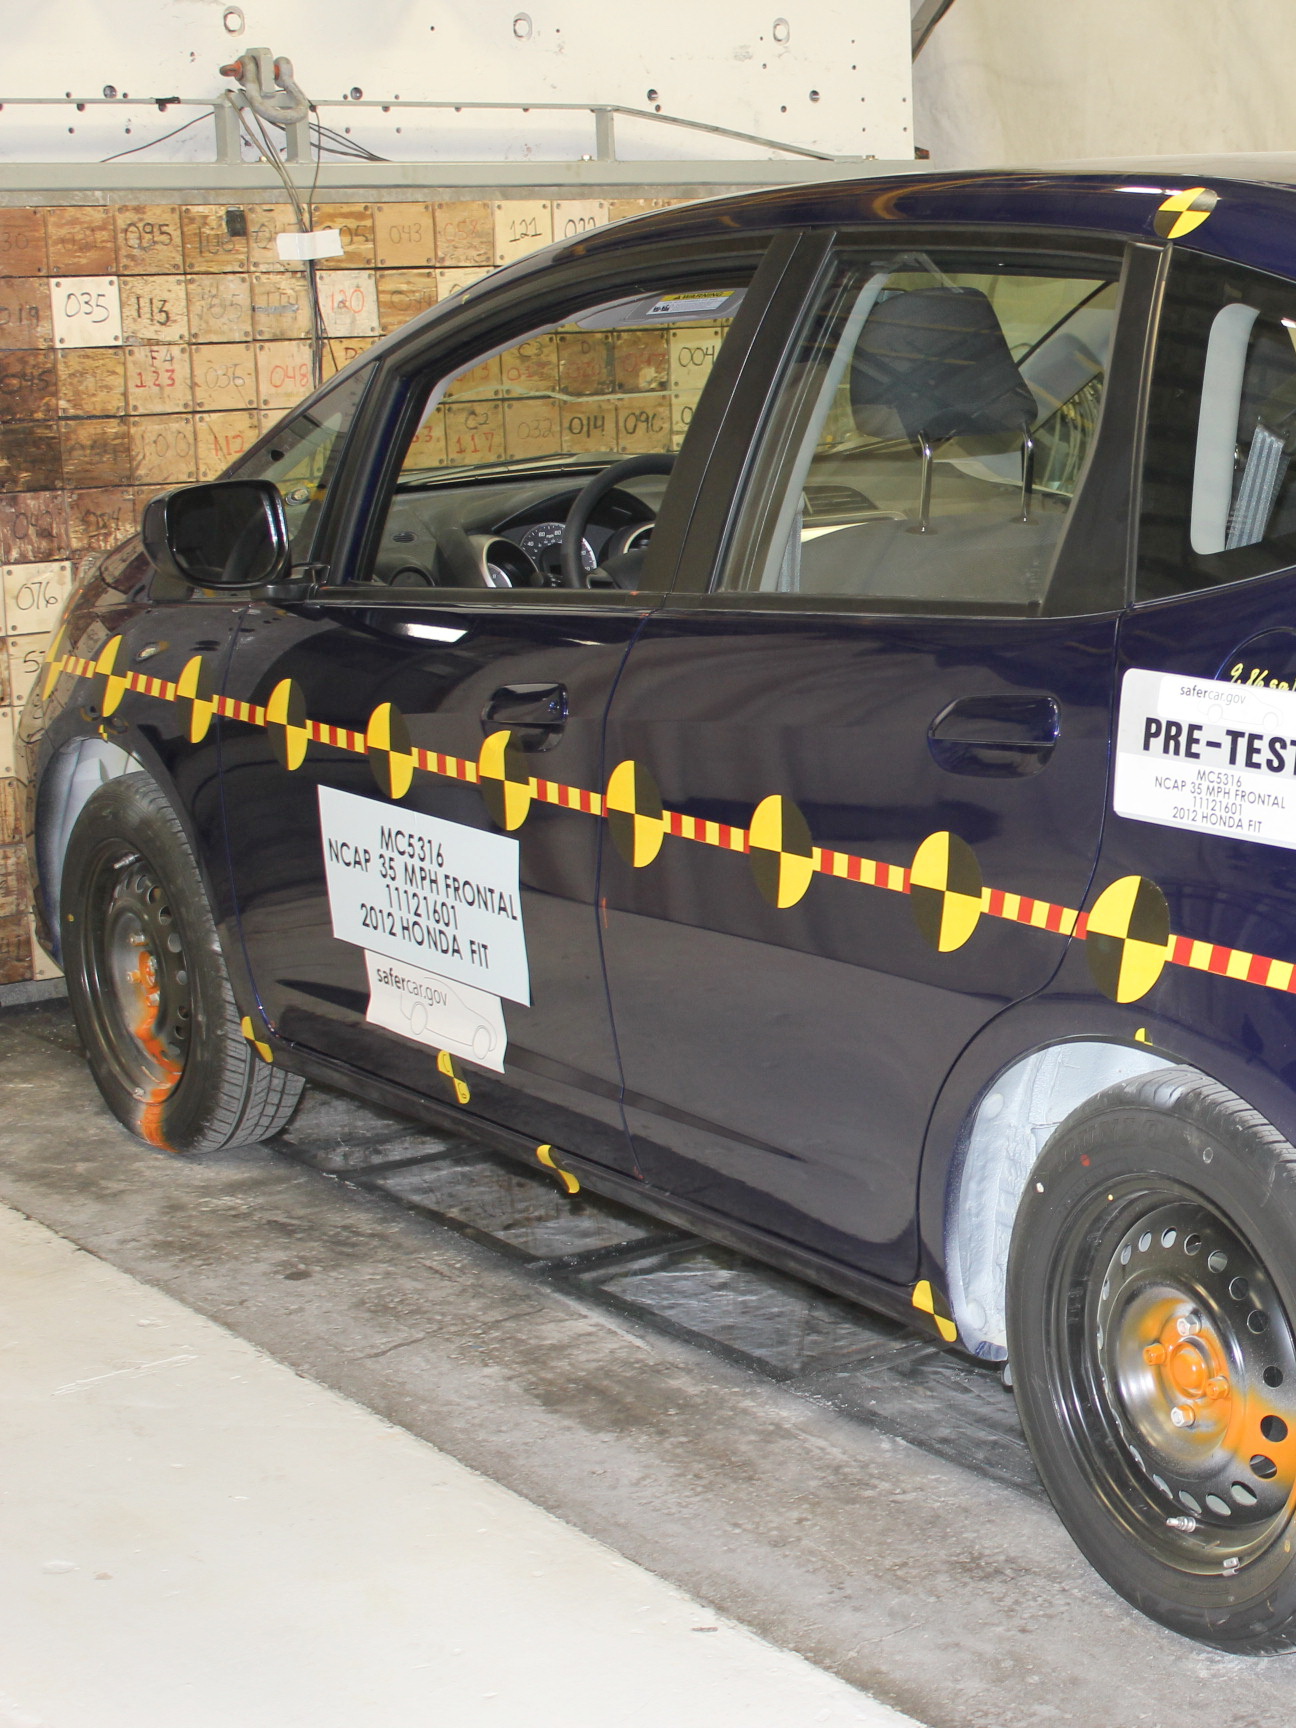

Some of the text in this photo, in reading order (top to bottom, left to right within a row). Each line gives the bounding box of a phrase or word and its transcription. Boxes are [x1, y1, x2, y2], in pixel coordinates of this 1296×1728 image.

[124, 222, 173, 250] 095
[322, 224, 369, 249] 05
[389, 222, 422, 245] 043
[508, 217, 543, 243] 121
[64, 292, 110, 323] 035
[136, 296, 170, 326] 113
[331, 288, 365, 314] 120
[678, 345, 715, 367] 004
[134, 368, 176, 388] 123
[270, 362, 310, 388] 048
[568, 415, 606, 438] 014
[455, 432, 495, 454] 117
[16, 581, 58, 611] 076
[1180, 684, 1247, 706] safercar.gov
[1196, 768, 1243, 789] MC5316
[1154, 775, 1286, 810] NCAP 35 MPH FRONTAL
[1192, 795, 1243, 816] 11121601
[1172, 806, 1263, 834] 2012 HONDA FIT
[380, 825, 445, 868] MC5316
[328, 837, 519, 921] NCAP 35 MPH FRONTAL
[385, 883, 459, 931] 11121601
[360, 903, 490, 970] 2012 HONDA FIT
[376, 967, 448, 1007] safercar.gov
